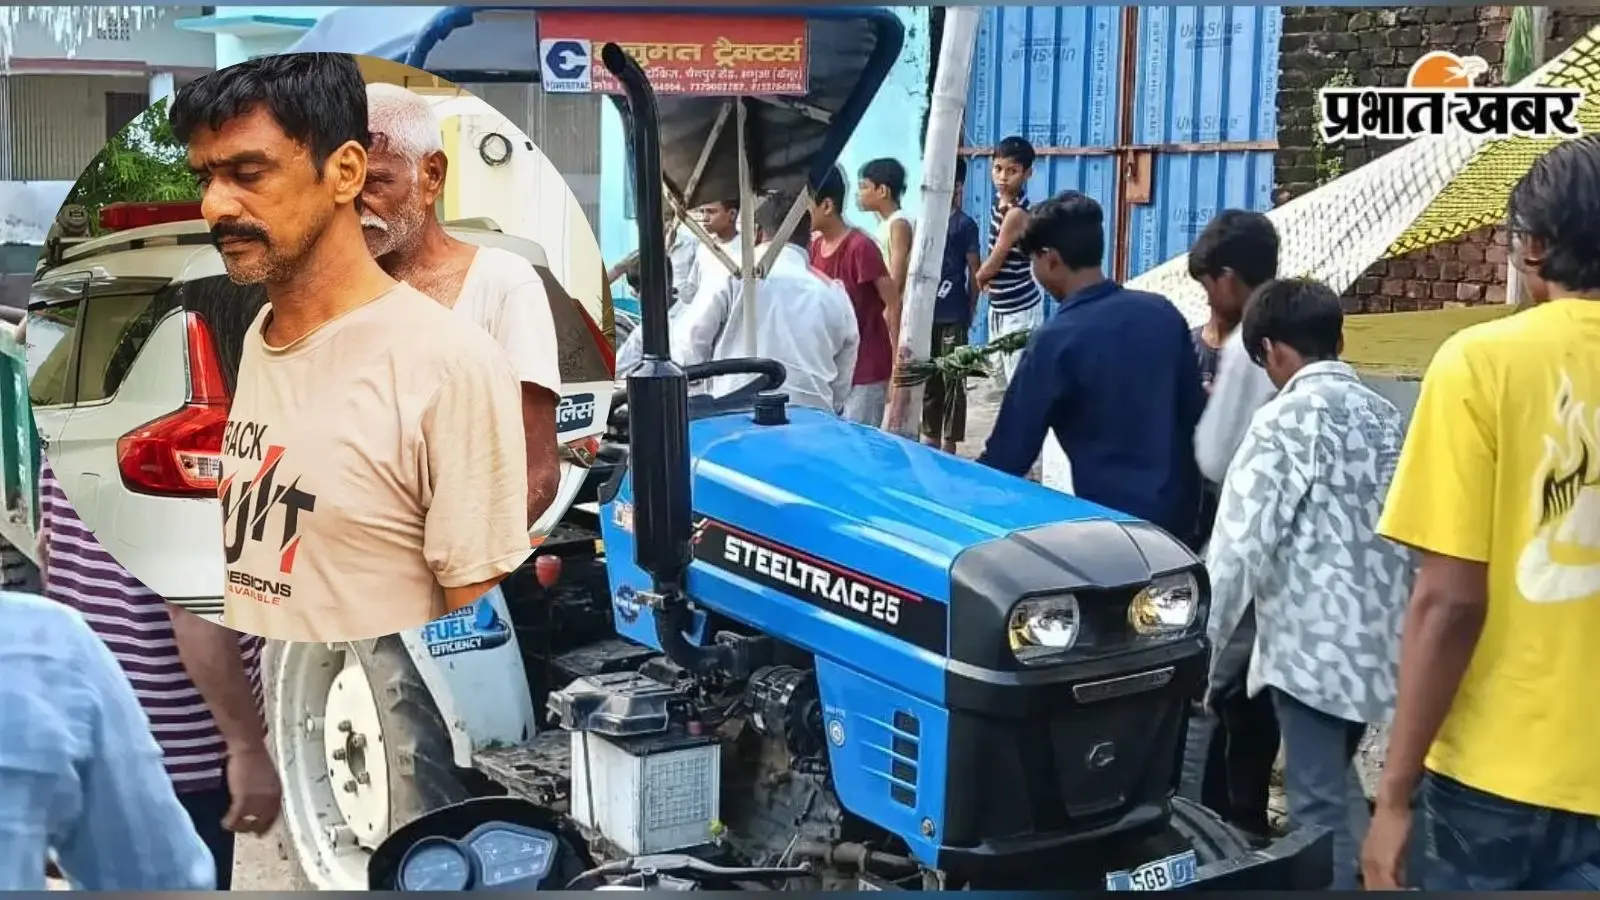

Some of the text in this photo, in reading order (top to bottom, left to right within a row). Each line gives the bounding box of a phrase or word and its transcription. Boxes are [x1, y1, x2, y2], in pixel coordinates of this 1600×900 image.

[556, 398, 595, 424] लिस
[227, 569, 292, 598] ESIGNS
[724, 535, 901, 625] STEELTRAC 25
[425, 617, 473, 642] FUEL
